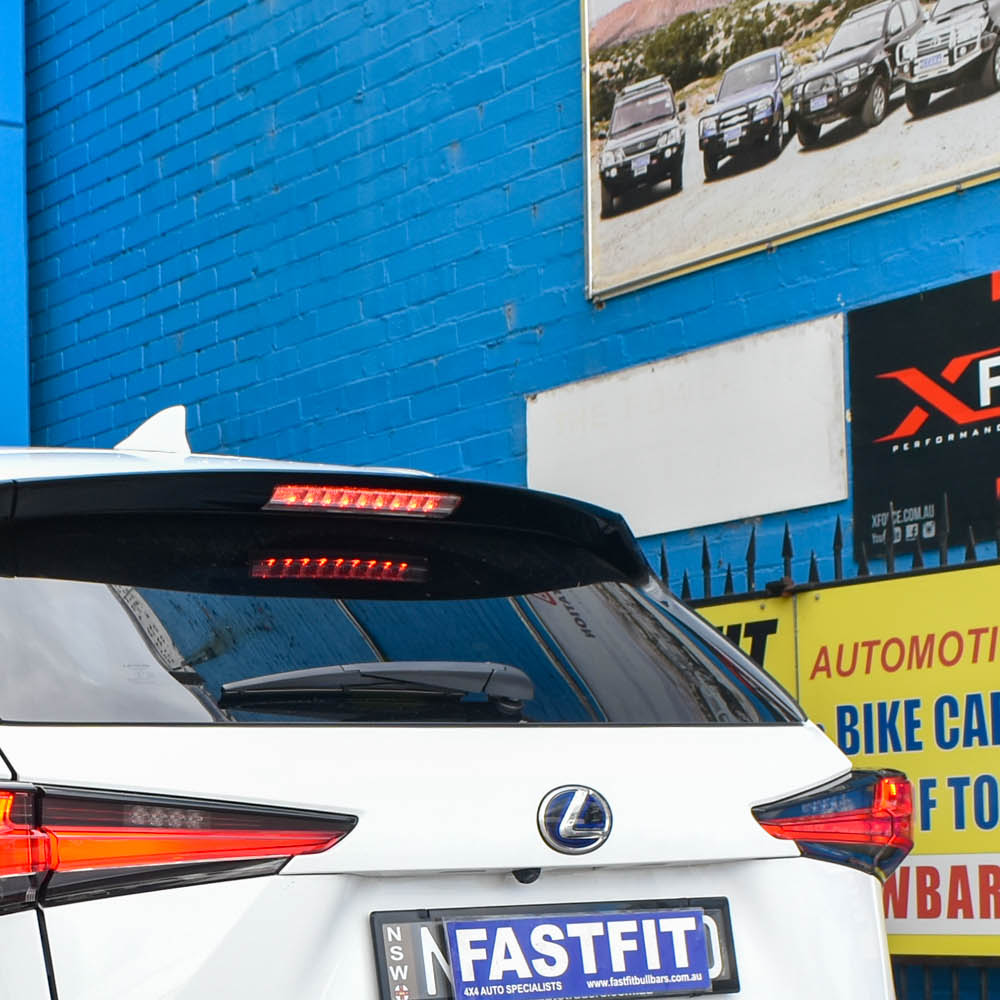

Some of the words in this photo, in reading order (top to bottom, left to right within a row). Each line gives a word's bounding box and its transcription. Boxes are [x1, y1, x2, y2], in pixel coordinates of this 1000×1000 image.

[836, 699, 923, 756] BIKE
[456, 917, 697, 982] FASTFIT
[464, 986, 480, 996] 4X4
[481, 984, 504, 995] AUTO
[506, 981, 563, 994] SPECIALISTS
[587, 973, 703, 989] www.fastfitbullbars.com.au
